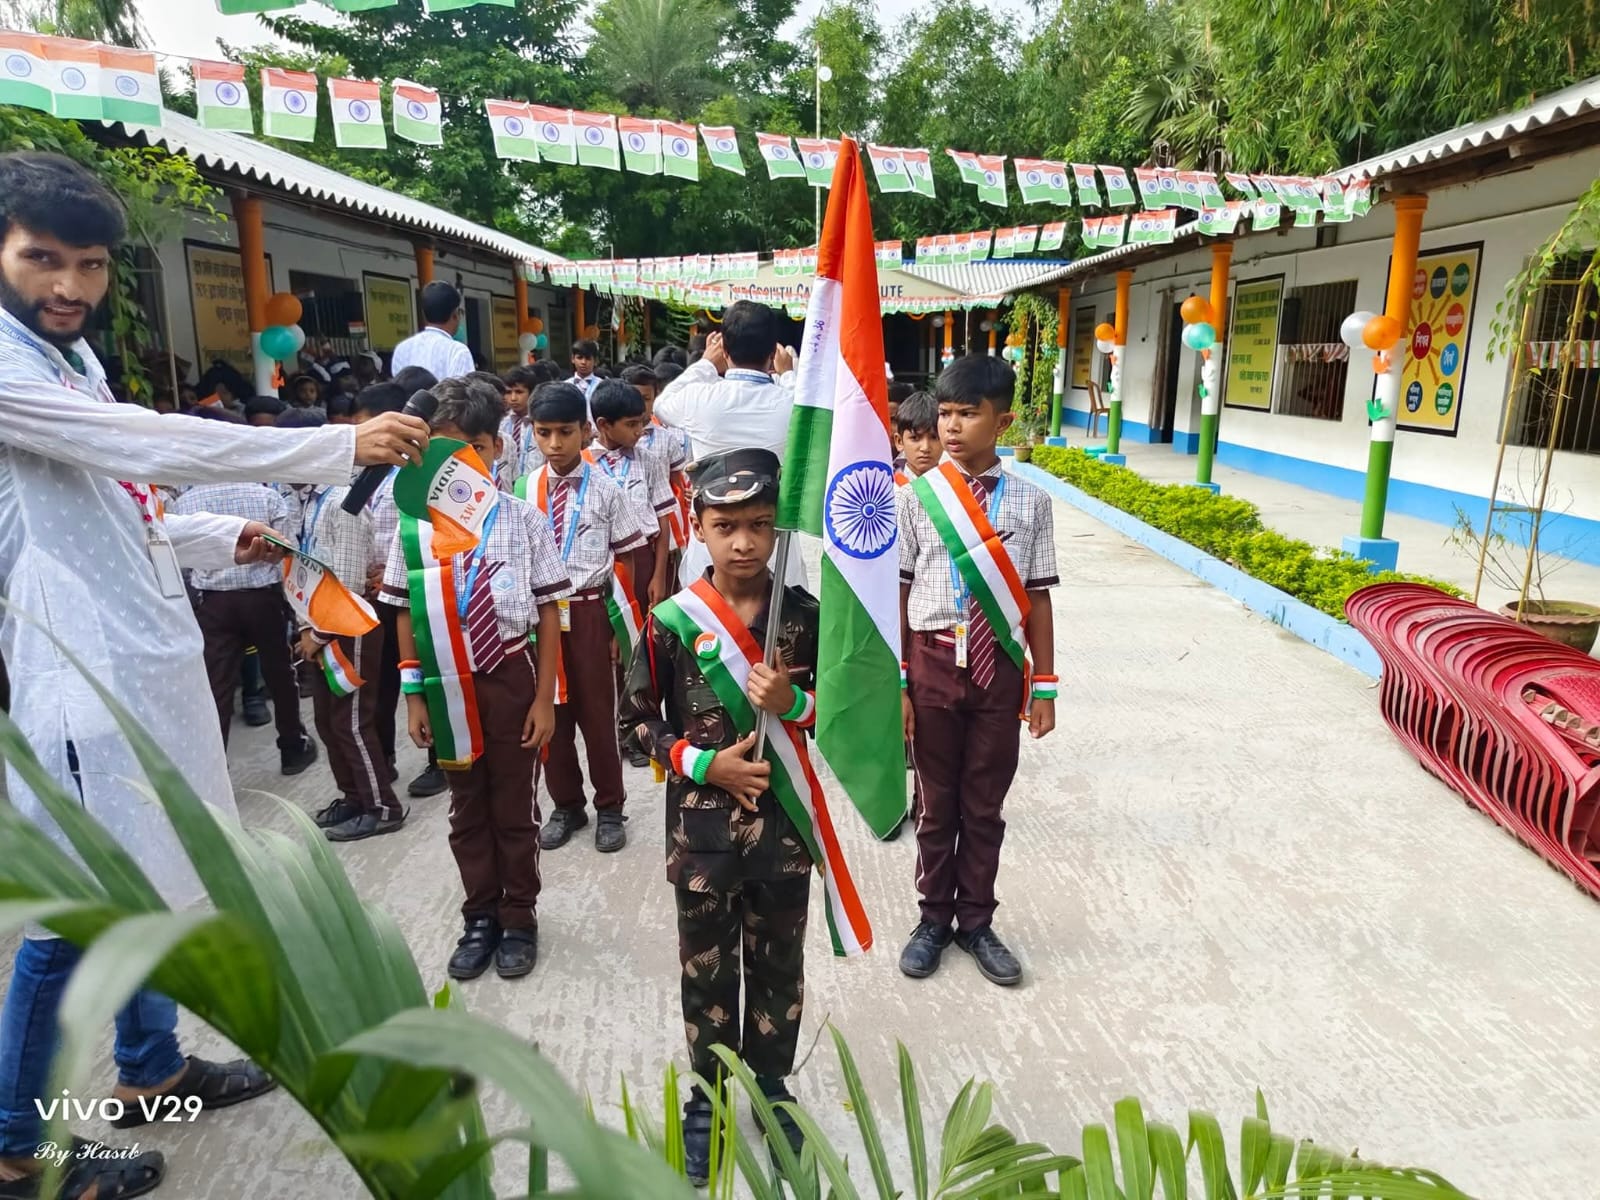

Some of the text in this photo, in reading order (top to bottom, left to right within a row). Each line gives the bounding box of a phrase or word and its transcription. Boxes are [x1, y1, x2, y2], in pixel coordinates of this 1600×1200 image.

[750, 284, 792, 300] GWTH
[880, 285, 903, 298] UTE
[430, 460, 459, 501] INDIA
[460, 503, 476, 523] MY
[296, 553, 322, 575] IND
